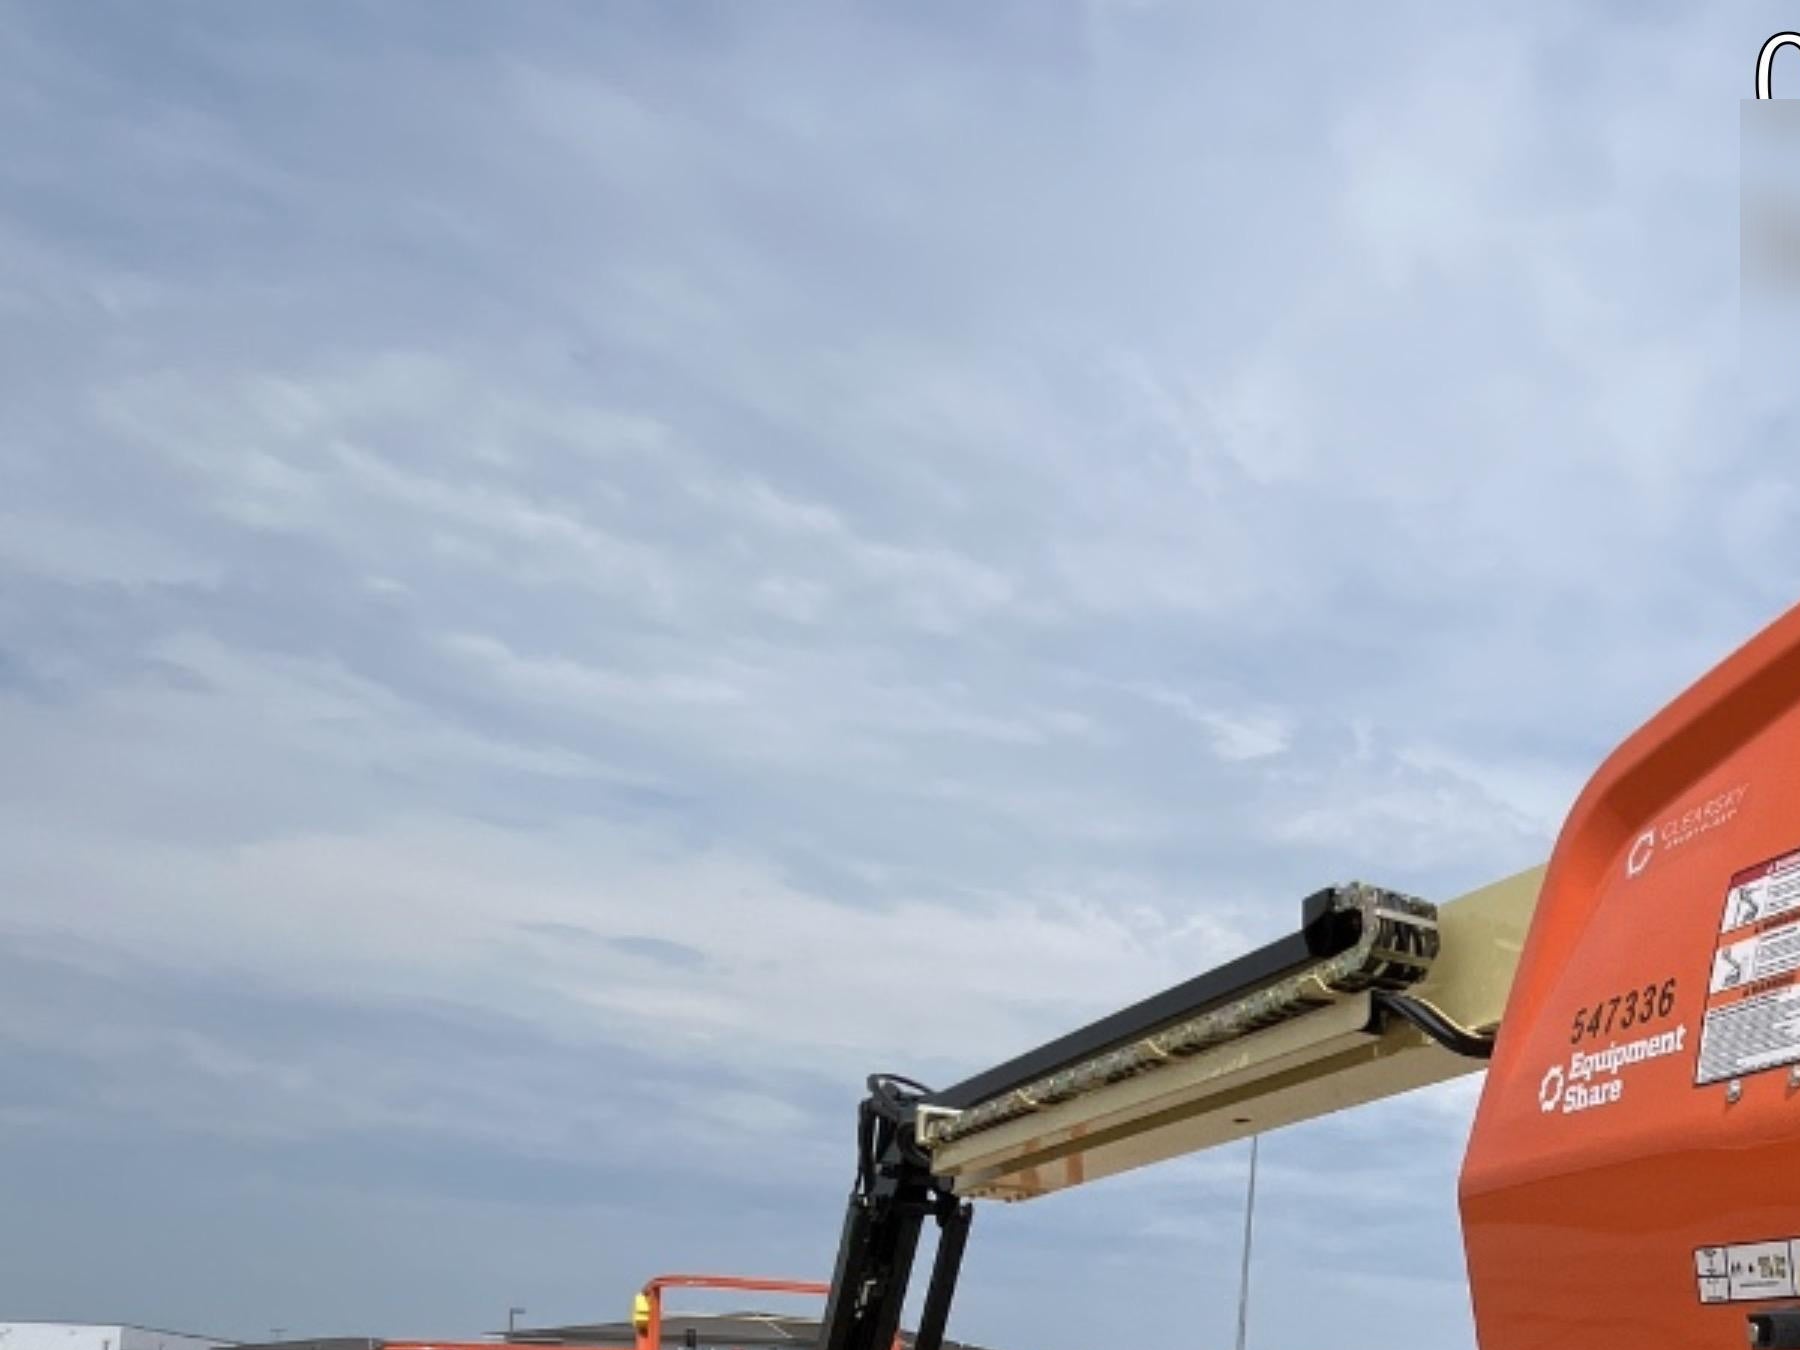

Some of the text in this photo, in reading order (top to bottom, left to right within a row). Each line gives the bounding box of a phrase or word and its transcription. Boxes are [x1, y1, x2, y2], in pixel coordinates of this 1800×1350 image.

[1570, 976, 1677, 1045] 547336
[1568, 1023, 1688, 1082] Equipment
[1561, 1078, 1624, 1114] Share
